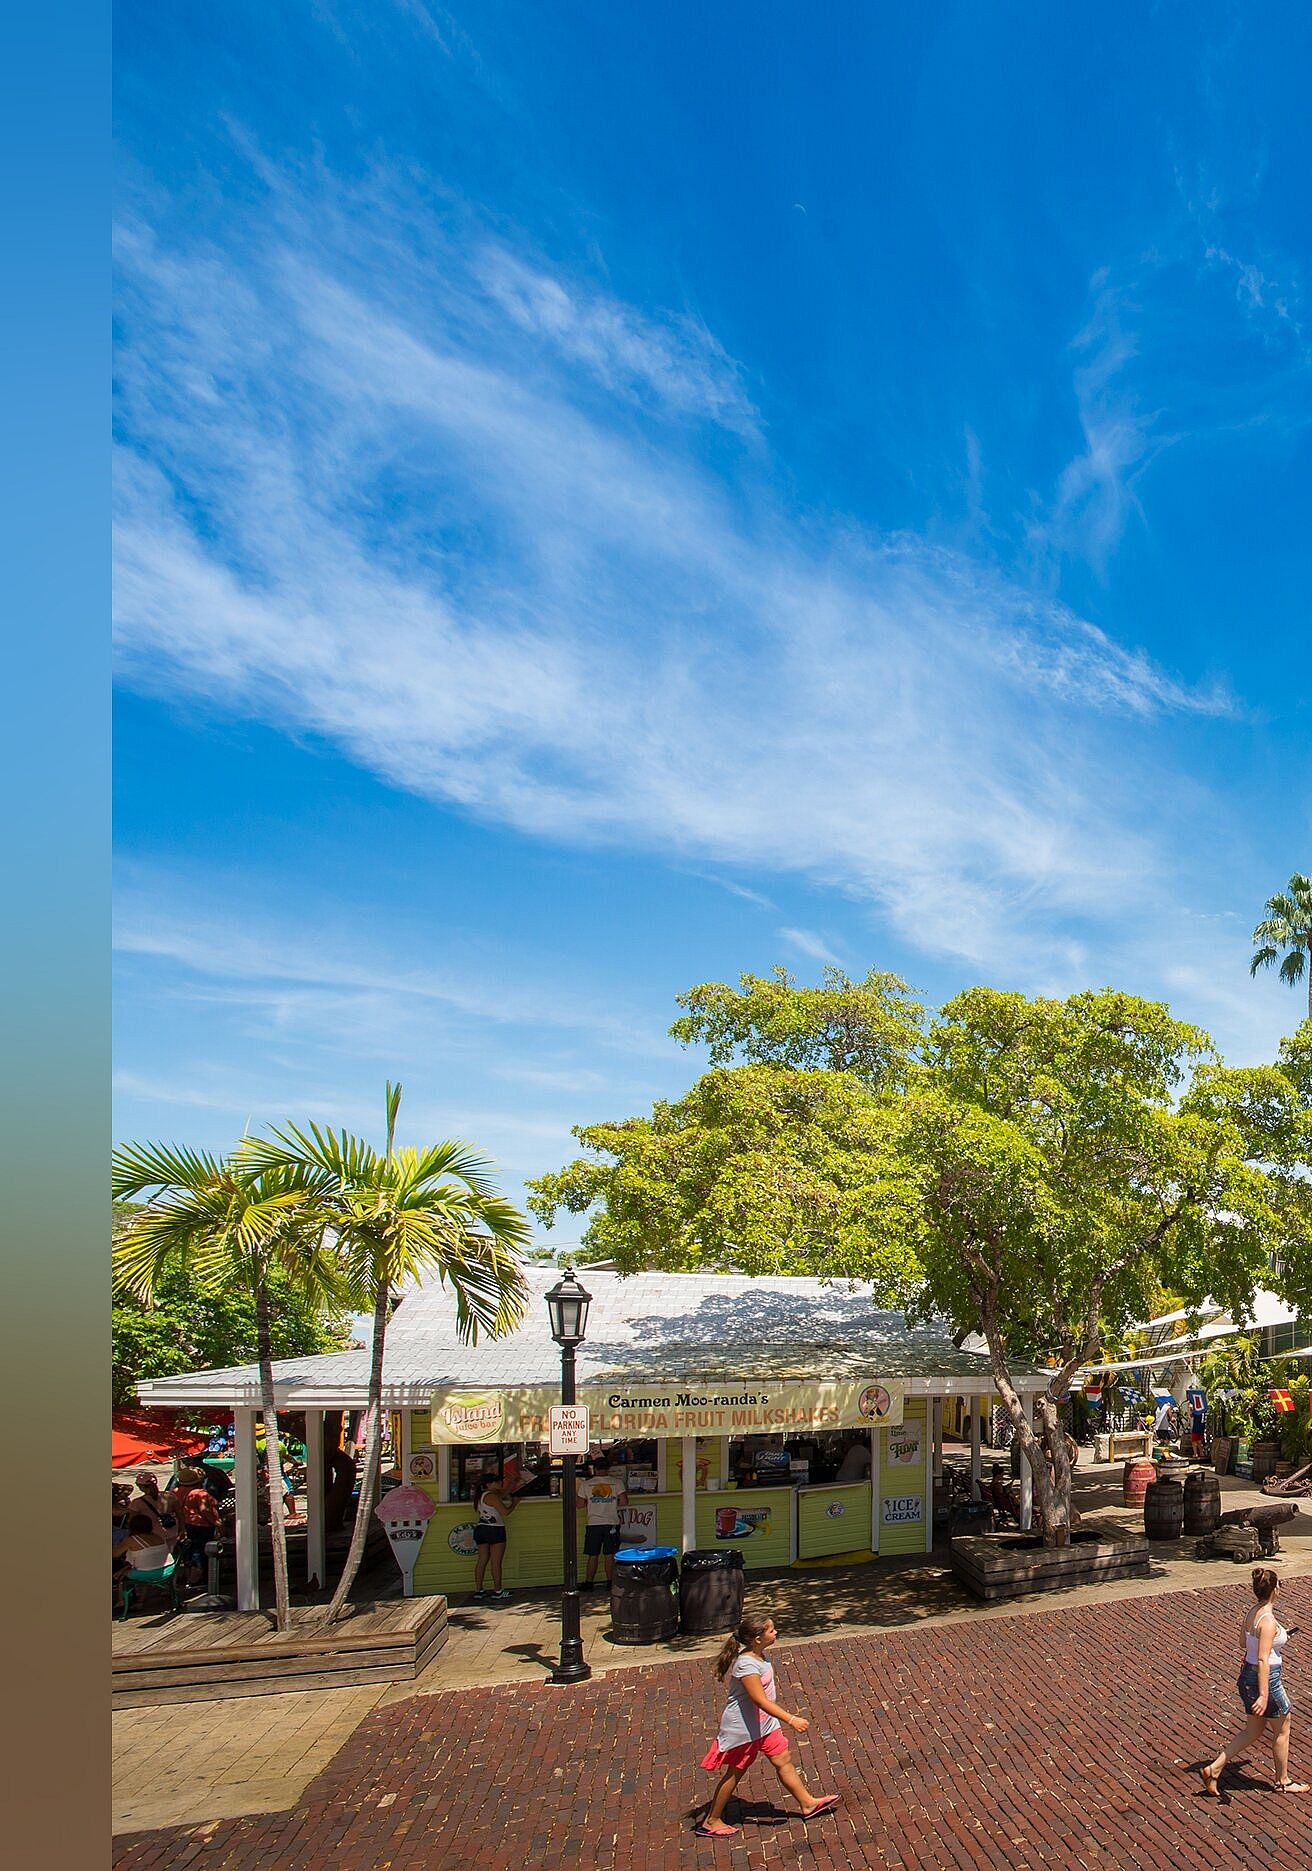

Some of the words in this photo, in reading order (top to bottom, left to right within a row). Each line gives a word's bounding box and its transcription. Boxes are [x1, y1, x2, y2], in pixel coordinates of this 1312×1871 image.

[608, 1394, 671, 1409] Carmen
[675, 1391, 769, 1407] Moo-randa's
[440, 1401, 502, 1425] Island
[561, 1410, 577, 1419] NO
[589, 1412, 668, 1432] FLORIDA
[675, 1410, 725, 1429] FRUIT
[731, 1407, 840, 1426] MILKSHAKES
[479, 1420, 497, 1430] bar
[552, 1420, 586, 1430] PARKING
[892, 1499, 914, 1512] ICE
[628, 1507, 653, 1528] DOG
[884, 1512, 920, 1521] CREAM
